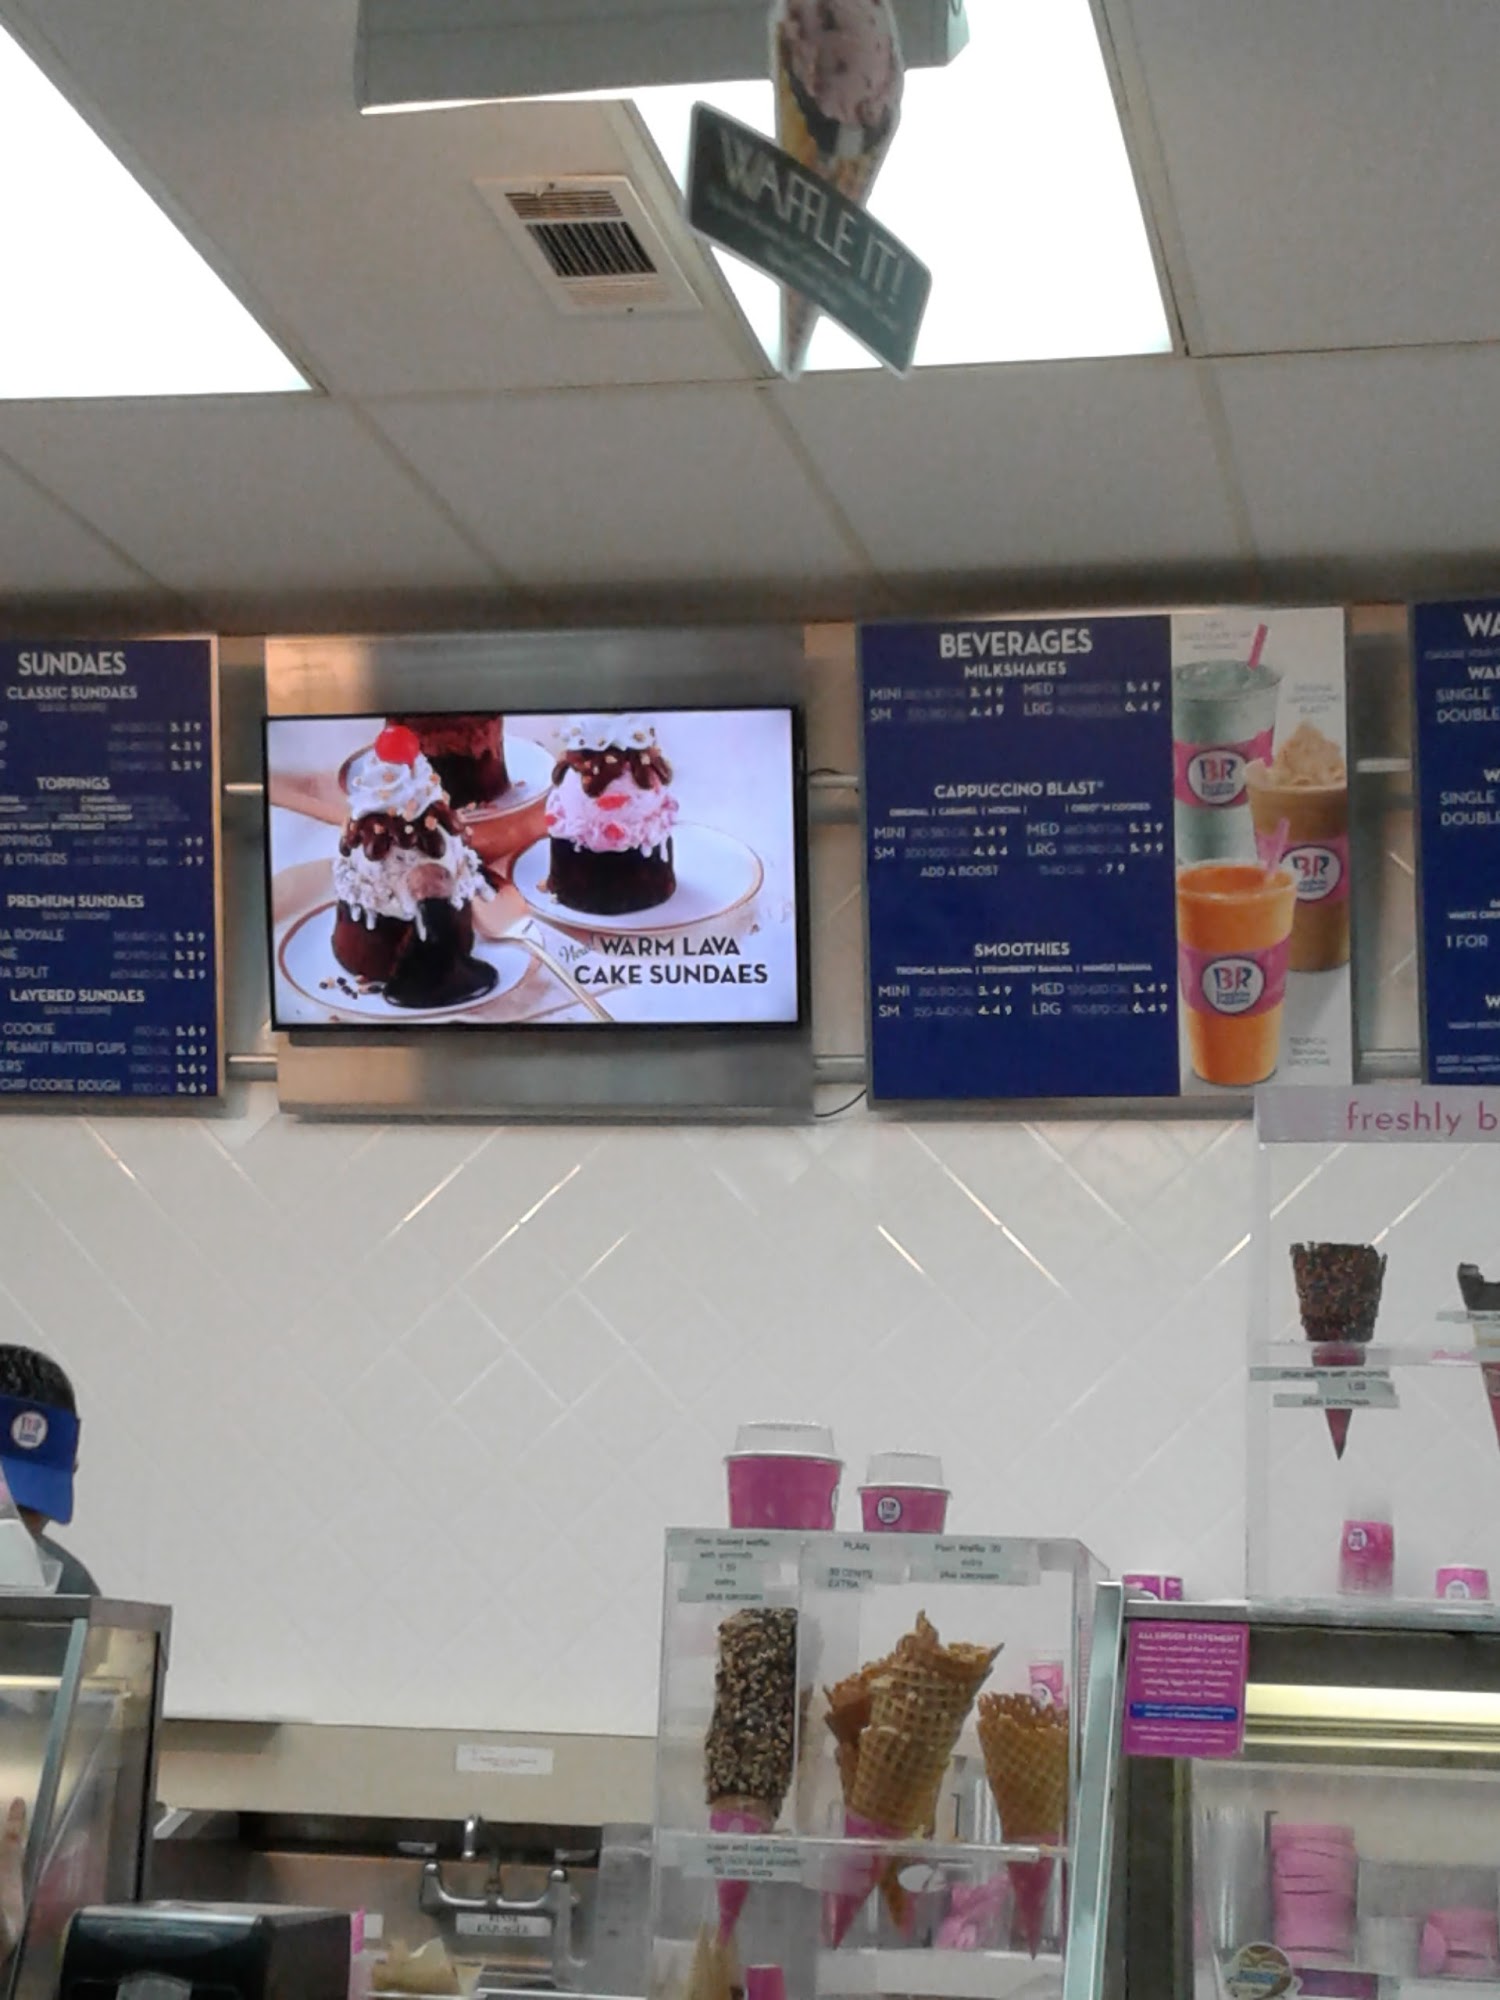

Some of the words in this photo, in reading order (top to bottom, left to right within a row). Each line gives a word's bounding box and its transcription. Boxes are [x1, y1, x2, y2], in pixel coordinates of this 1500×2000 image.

[721, 127, 857, 267] WAFFLE
[860, 232, 905, 305] IT!
[940, 628, 1093, 659] BEVERAGES
[18, 651, 127, 676] SUNDAES
[964, 661, 1067, 678] MILKSHAKES
[7, 686, 67, 700] CLASSIC
[71, 686, 138, 700] SUNDAES
[870, 688, 901, 701] MINI
[1023, 682, 1054, 695] MED
[1436, 687, 1491, 702] SINGLE
[870, 708, 892, 721] SM
[1023, 702, 1053, 716] LRG
[1437, 708, 1500, 724] DOUBLE
[36, 776, 110, 790] TOPPINGS
[934, 782, 1042, 798] CAPPUCCINO
[1440, 790, 1495, 806] SINGLE
[874, 826, 906, 839] MINI
[1026, 823, 1060, 836] MED
[874, 846, 895, 859] SM
[1027, 842, 1057, 856] LRG
[920, 866, 945, 878] ADD
[948, 866, 956, 876] A
[958, 865, 998, 877] BOOST
[7, 895, 75, 908] PREMIUM
[78, 895, 144, 908] SUNDAES
[14, 929, 64, 941] ROYALE
[1456, 935, 1488, 948] FOR
[600, 936, 674, 957] WARM
[683, 936, 741, 956] LAVA
[974, 942, 1070, 957] SMOOTHIES
[15, 966, 49, 979] SPLIT
[574, 964, 642, 984] CAKE
[650, 964, 768, 984] SUNDAES
[1213, 966, 1252, 990] BR
[878, 985, 911, 998] MINI
[1031, 982, 1065, 995] MED
[10, 989, 75, 1002] LAYERED
[78, 989, 145, 1003] SUNDAES
[878, 1004, 900, 1017] SM
[1032, 1002, 1062, 1016] LRG
[3, 1023, 56, 1035] COOKIE
[7, 1042, 49, 1054] PEANUT
[51, 1042, 93, 1055] BUTTER
[96, 1043, 127, 1055] CUPS
[30, 1079, 74, 1091] COOKIE
[77, 1079, 120, 1092] DOUGH
[1347, 1101, 1461, 1137] freshly
[843, 1541, 870, 1551] PLAIN
[828, 1579, 859, 1588] EXTRA
